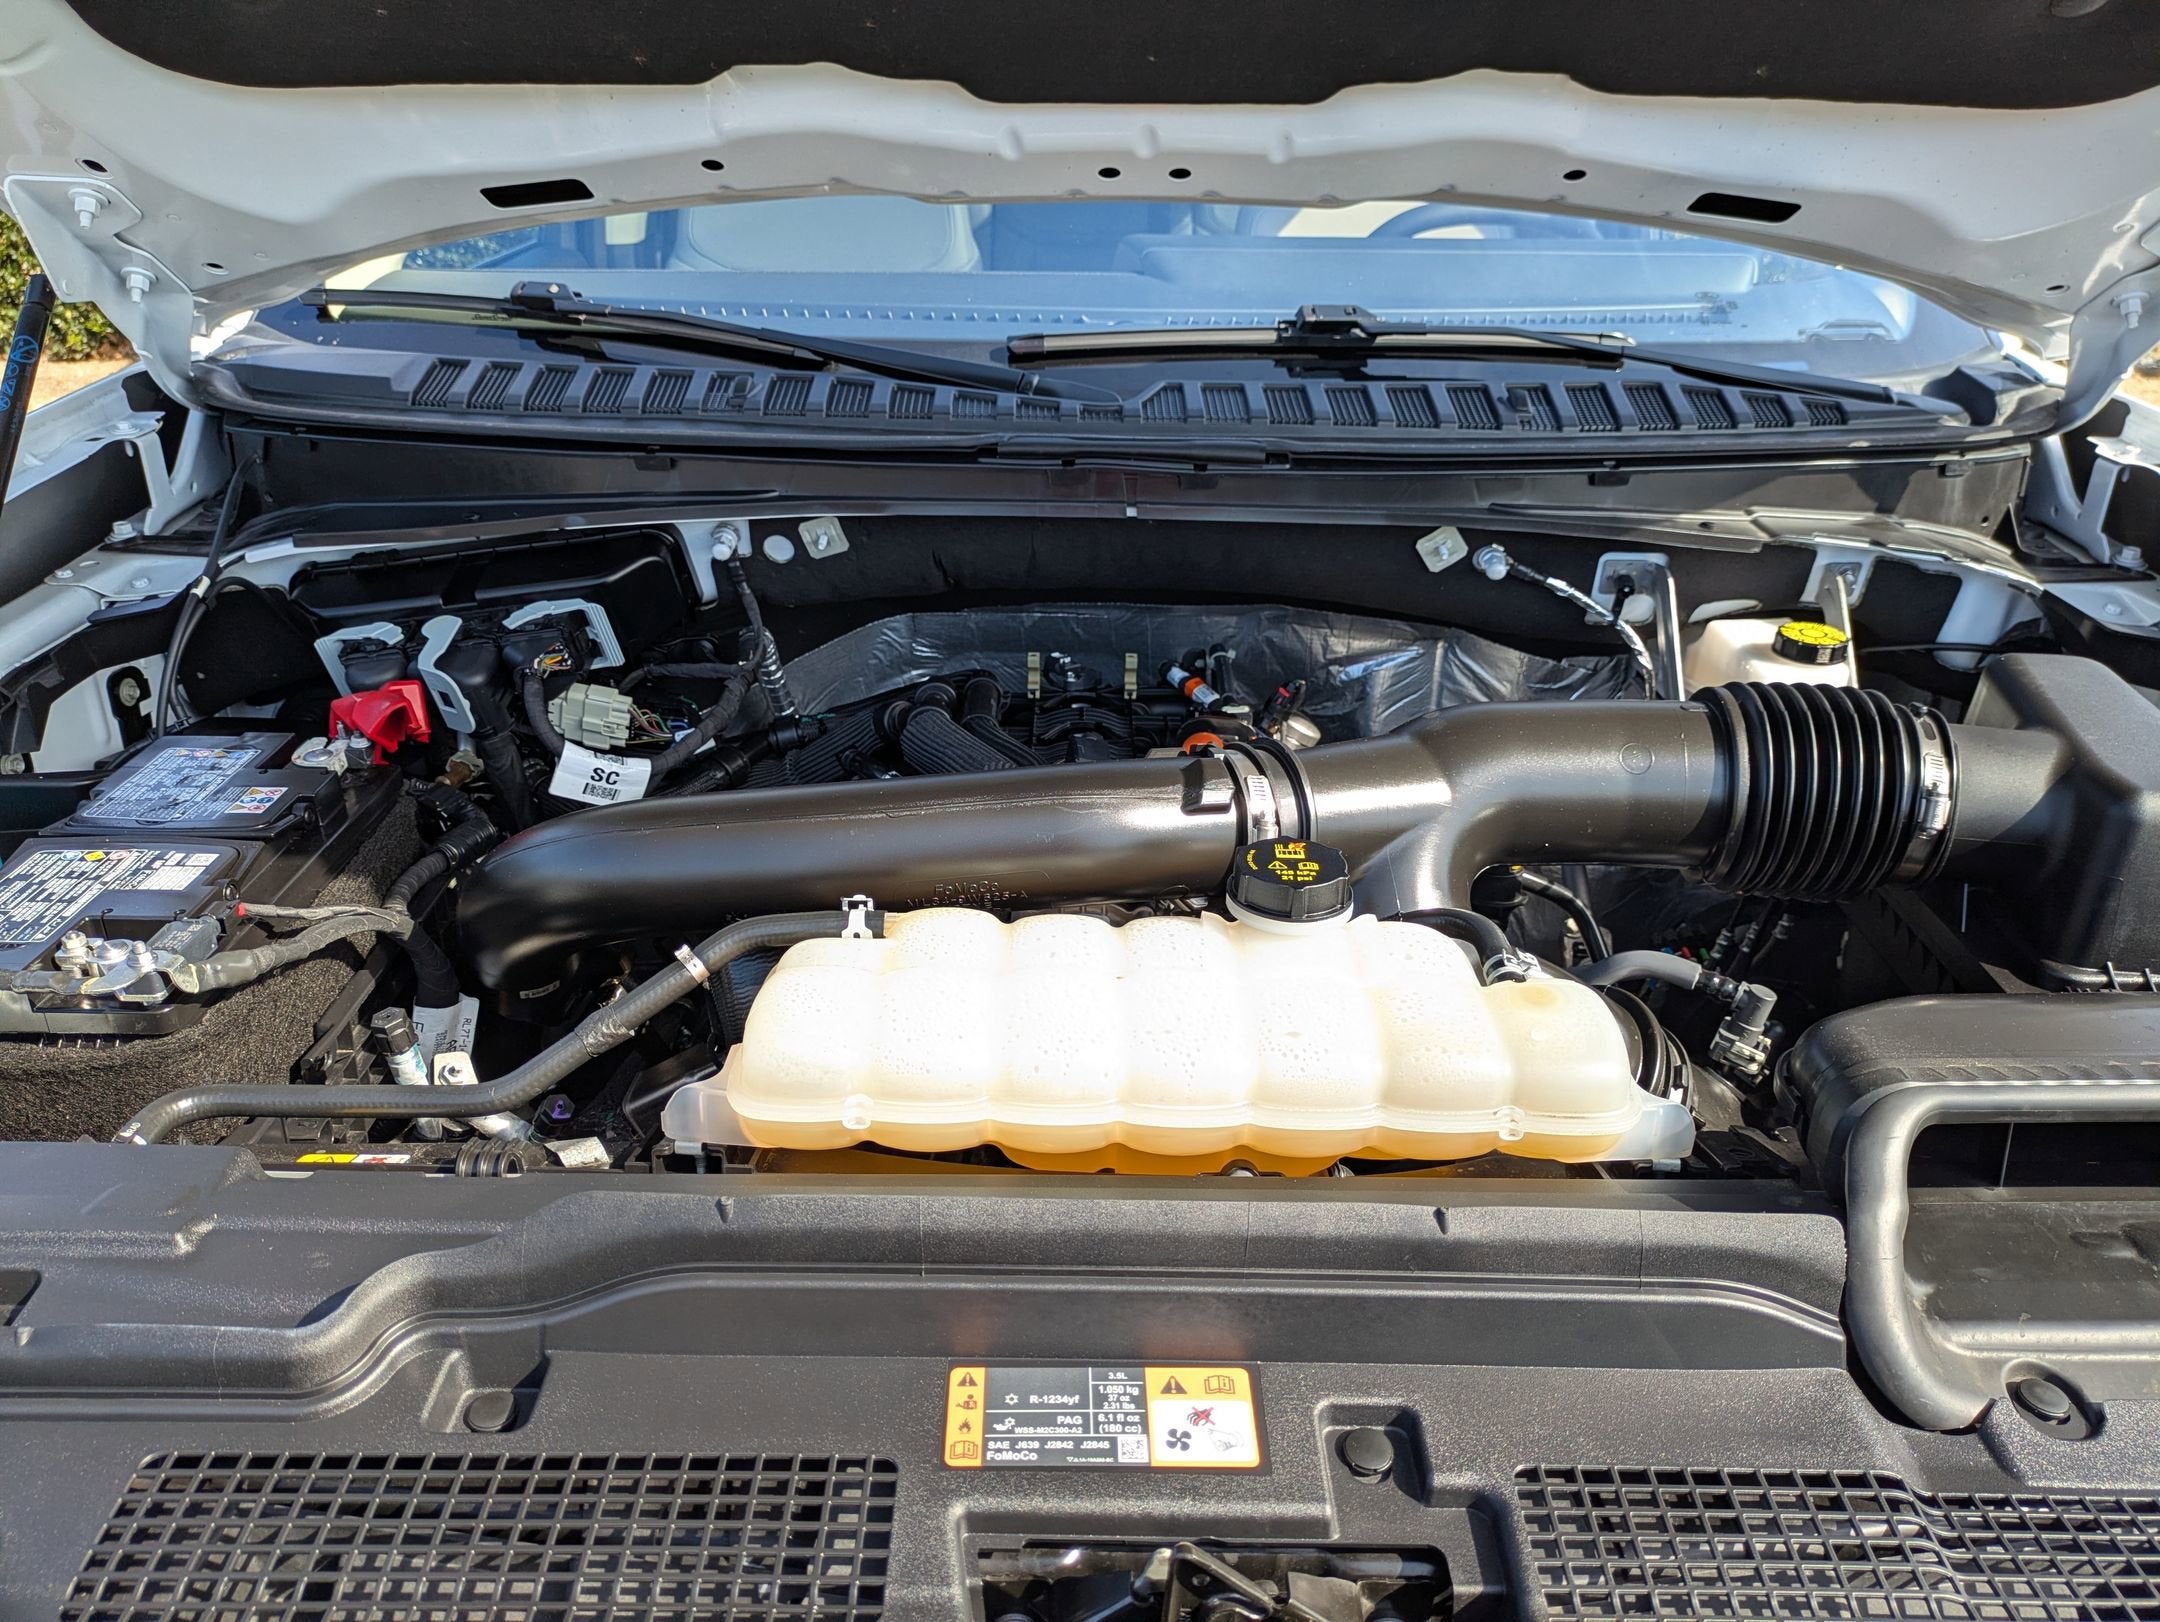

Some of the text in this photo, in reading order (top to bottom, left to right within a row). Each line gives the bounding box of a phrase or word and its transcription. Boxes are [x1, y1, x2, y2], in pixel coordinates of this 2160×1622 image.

[590, 767, 620, 785] SC
[935, 881, 999, 895] FoMoCo
[1108, 1372, 1128, 1380] 3.5L
[1099, 1385, 1139, 1395] 1.050 kg
[1029, 1394, 1080, 1406] R-1234yf
[1108, 1394, 1118, 1402] 37
[1103, 1402, 1136, 1410] 2.31 lbs
[1057, 1415, 1083, 1424] PAG
[1098, 1414, 1114, 1422] 6.1
[1116, 1414, 1125, 1422] fl
[1098, 1424, 1142, 1434] (180 cc)
[987, 1441, 1110, 1449] SAE J639 J2842 J2845
[986, 1450, 1038, 1461] FoMoCo
